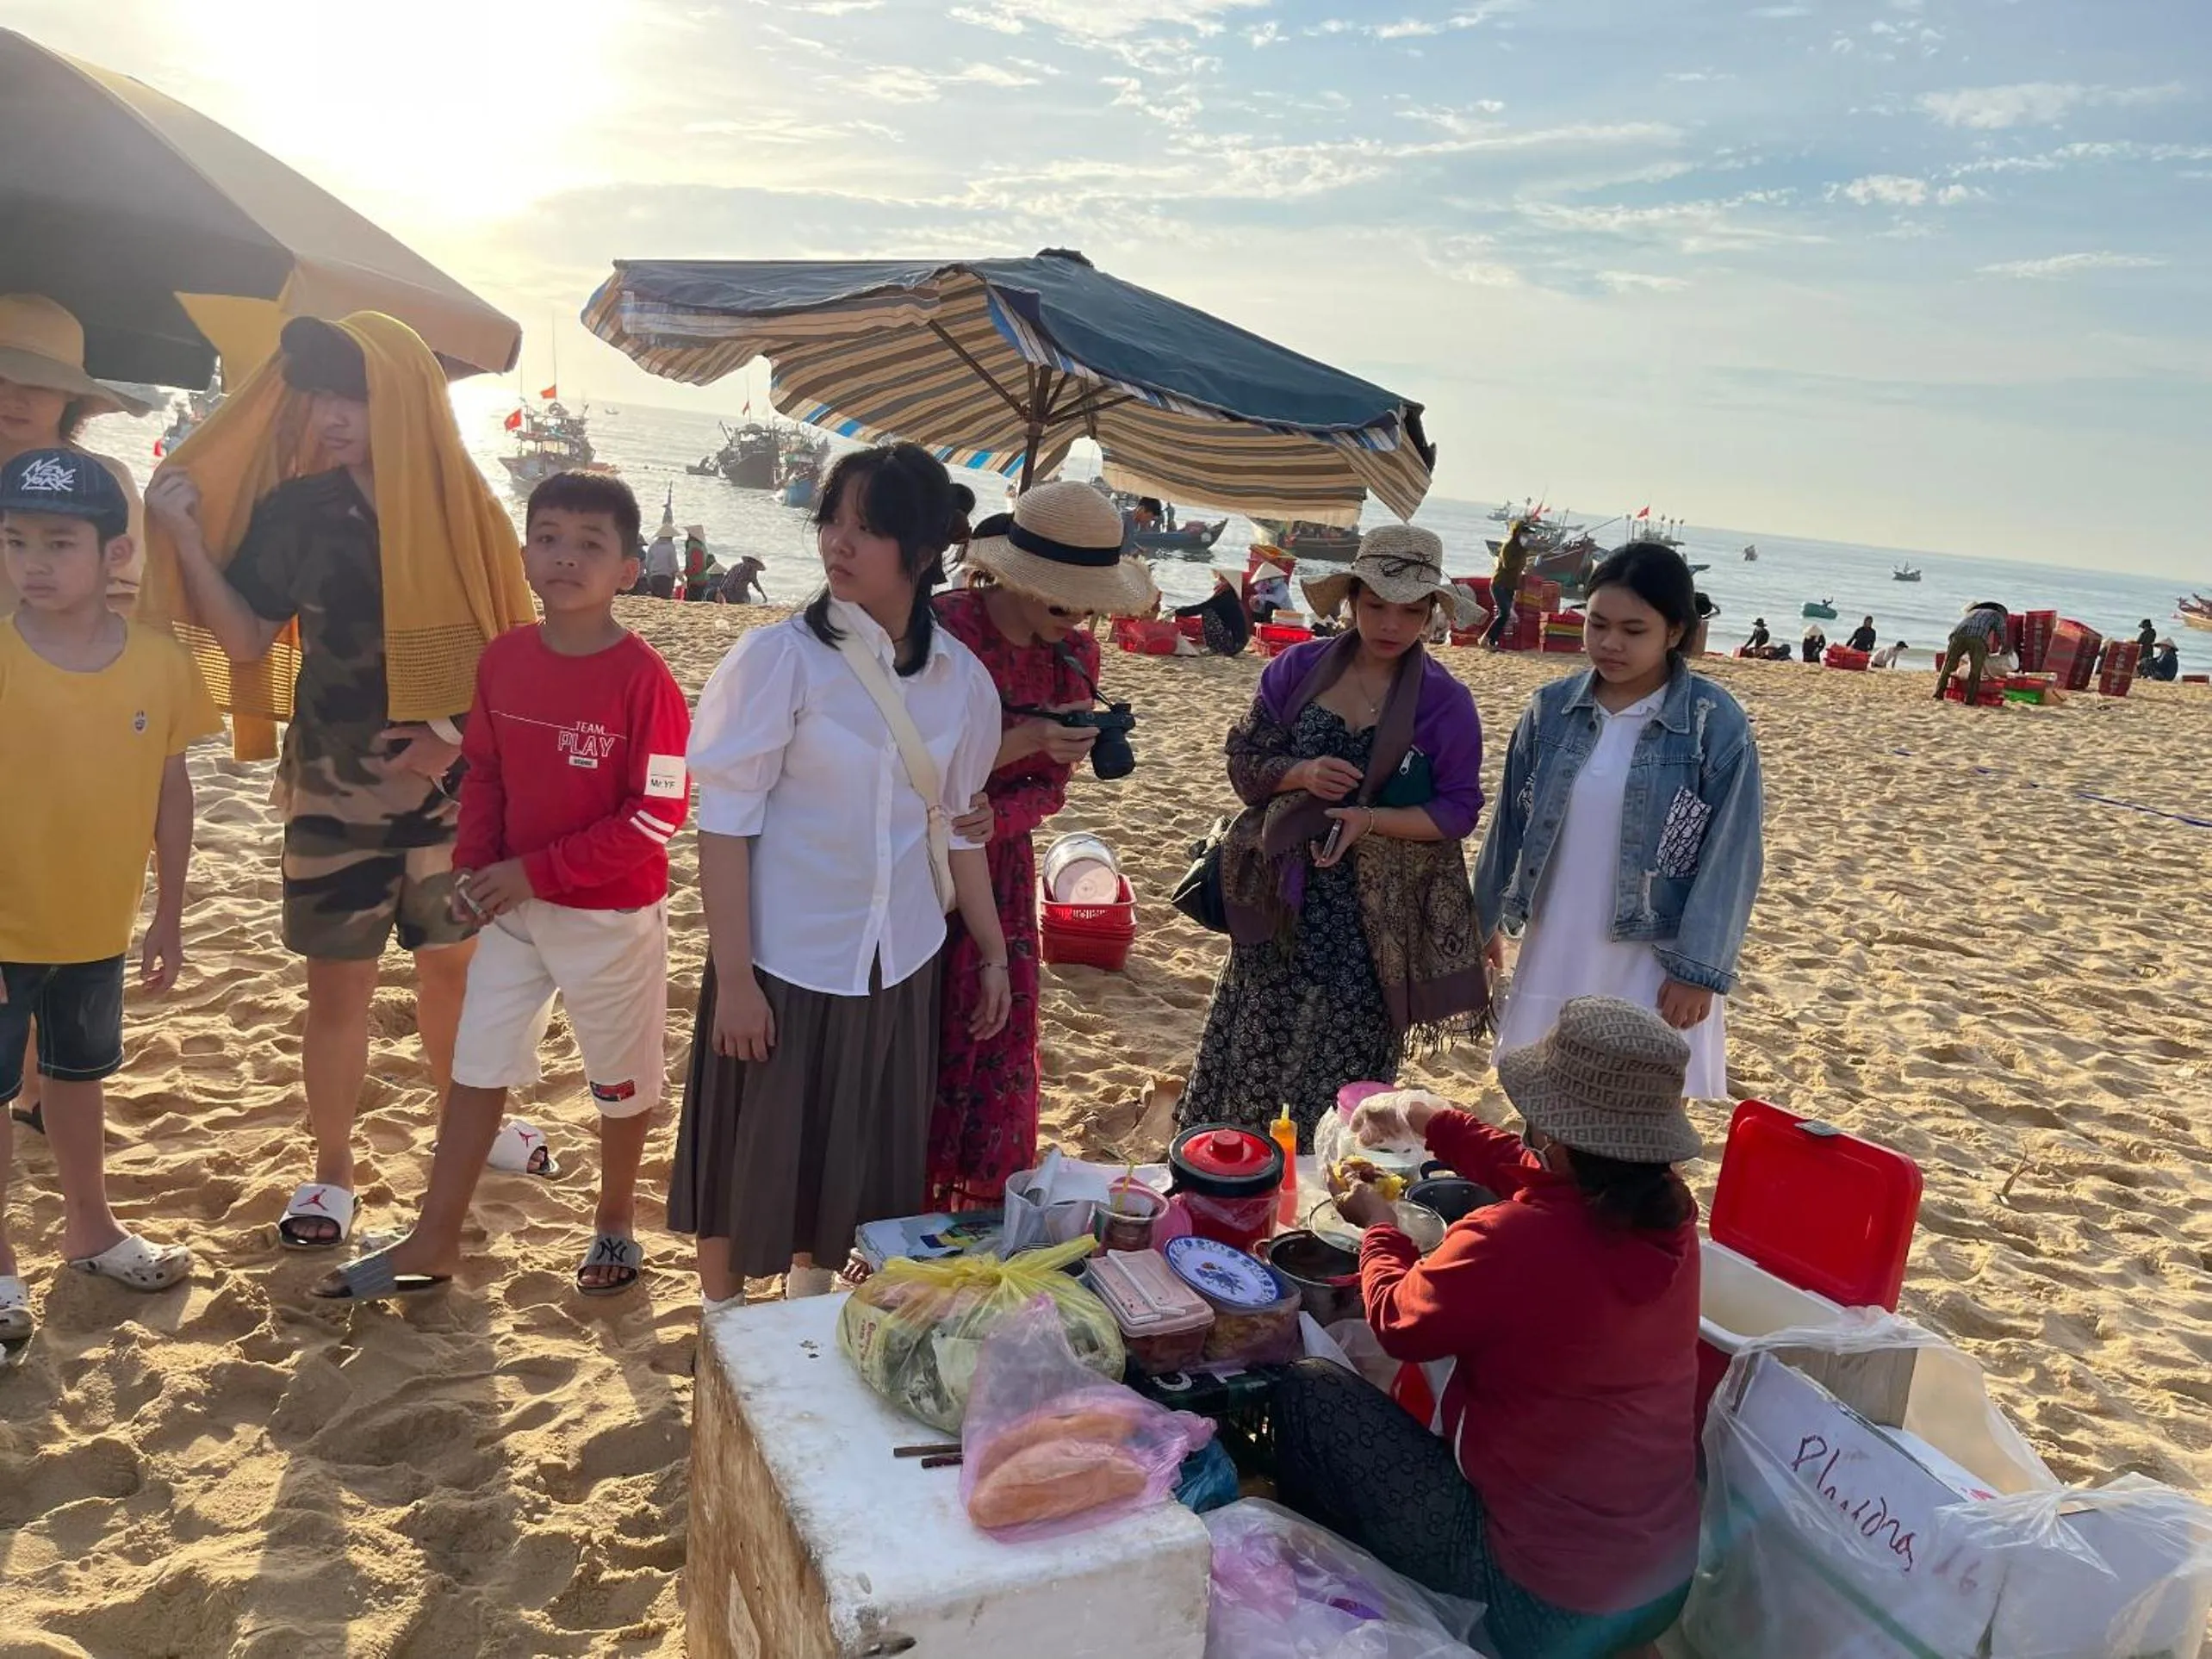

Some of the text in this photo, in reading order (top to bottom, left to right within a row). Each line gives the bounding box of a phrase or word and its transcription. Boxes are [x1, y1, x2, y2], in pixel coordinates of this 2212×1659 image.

[22, 472, 75, 492] YORK
[575, 721, 606, 735] TEAM
[557, 730, 616, 757] PLAY
